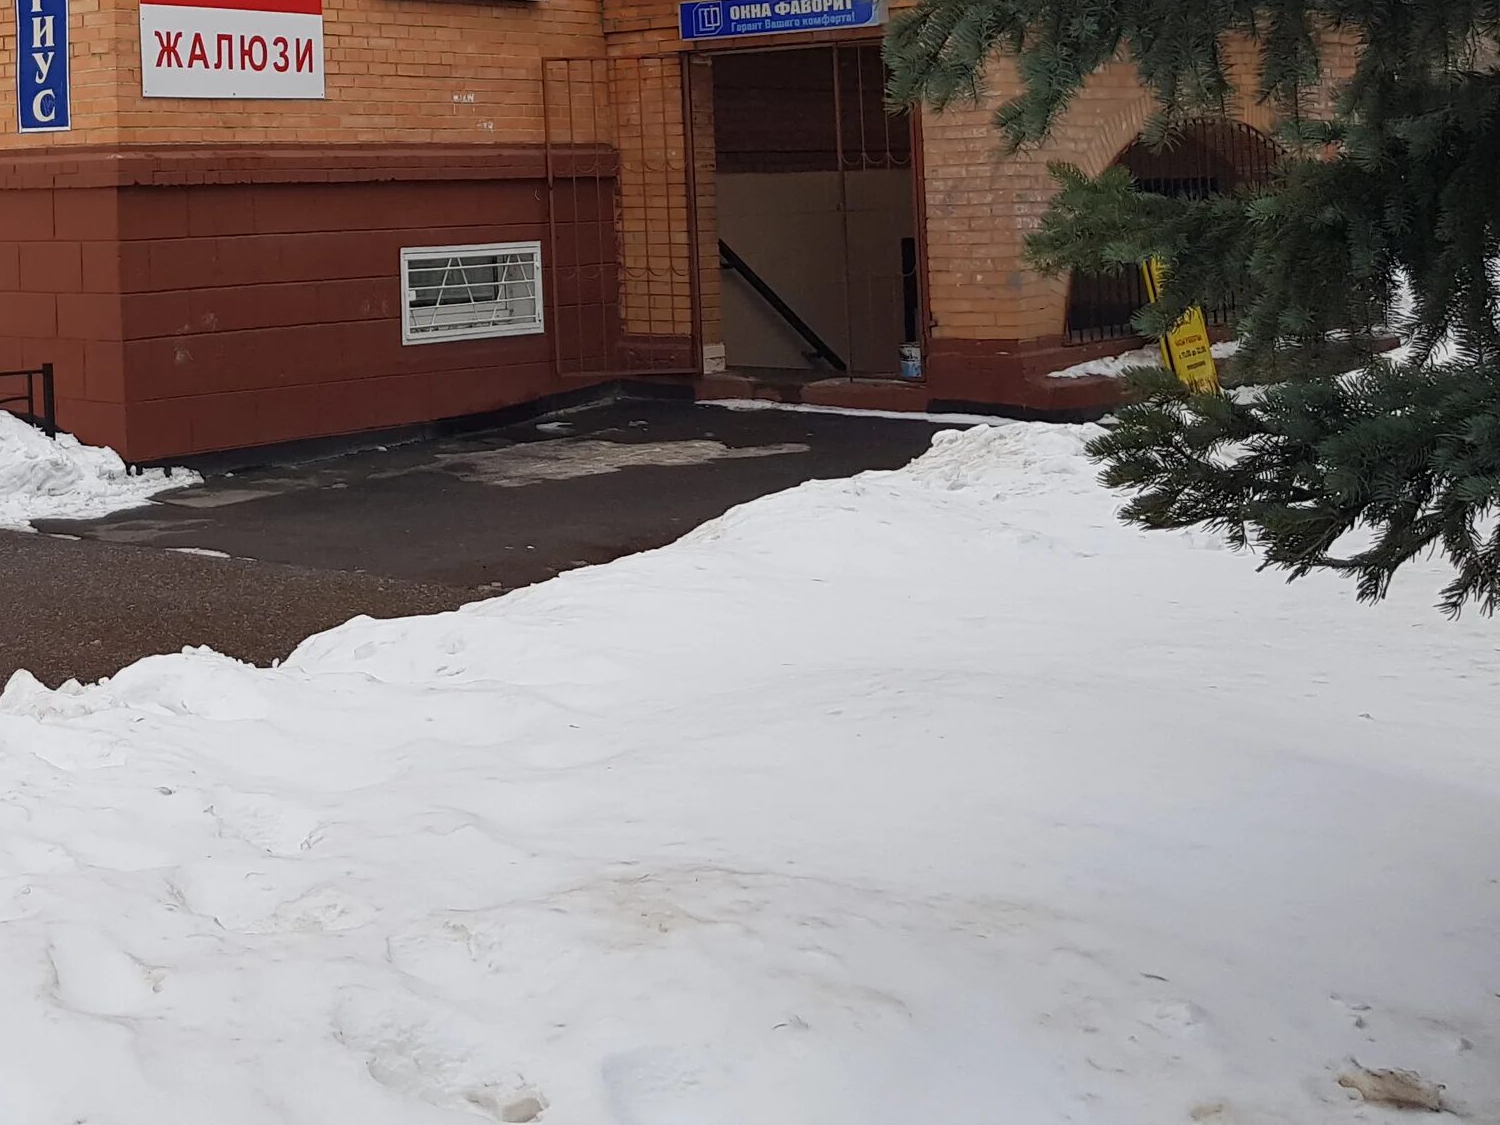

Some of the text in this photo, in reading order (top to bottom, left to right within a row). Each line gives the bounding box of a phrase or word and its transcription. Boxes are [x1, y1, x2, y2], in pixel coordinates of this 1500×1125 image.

[729, 2, 772, 21] ОКНА
[764, 18, 801, 30] Вашего
[802, 11, 856, 27] комфорта!
[154, 29, 314, 73] ЖАЛЮЗИ
